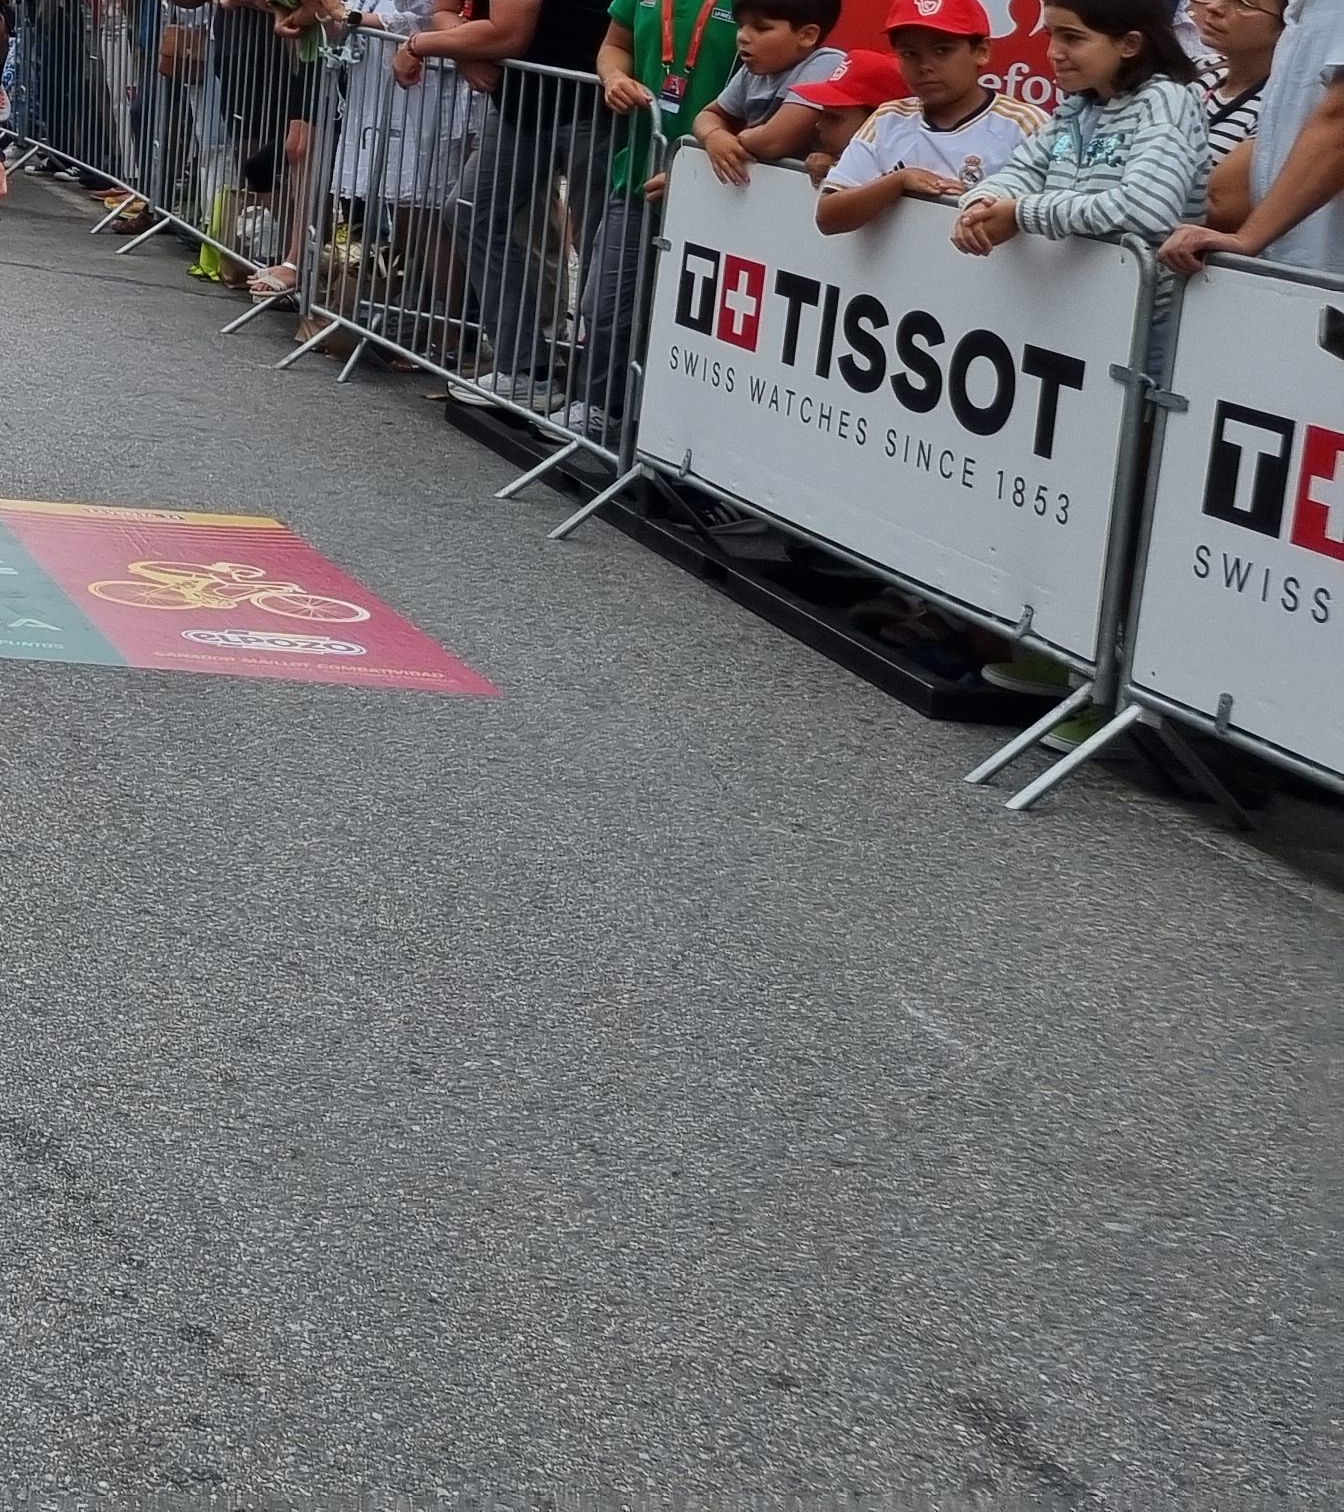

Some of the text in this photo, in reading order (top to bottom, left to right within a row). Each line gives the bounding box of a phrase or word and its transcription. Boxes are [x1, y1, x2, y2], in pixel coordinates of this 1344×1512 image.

[670, 346, 1071, 525] SWISS WATCHES SINCE 1853
[775, 268, 1086, 460] TISSOT
[1192, 545, 1330, 624] SWISS
